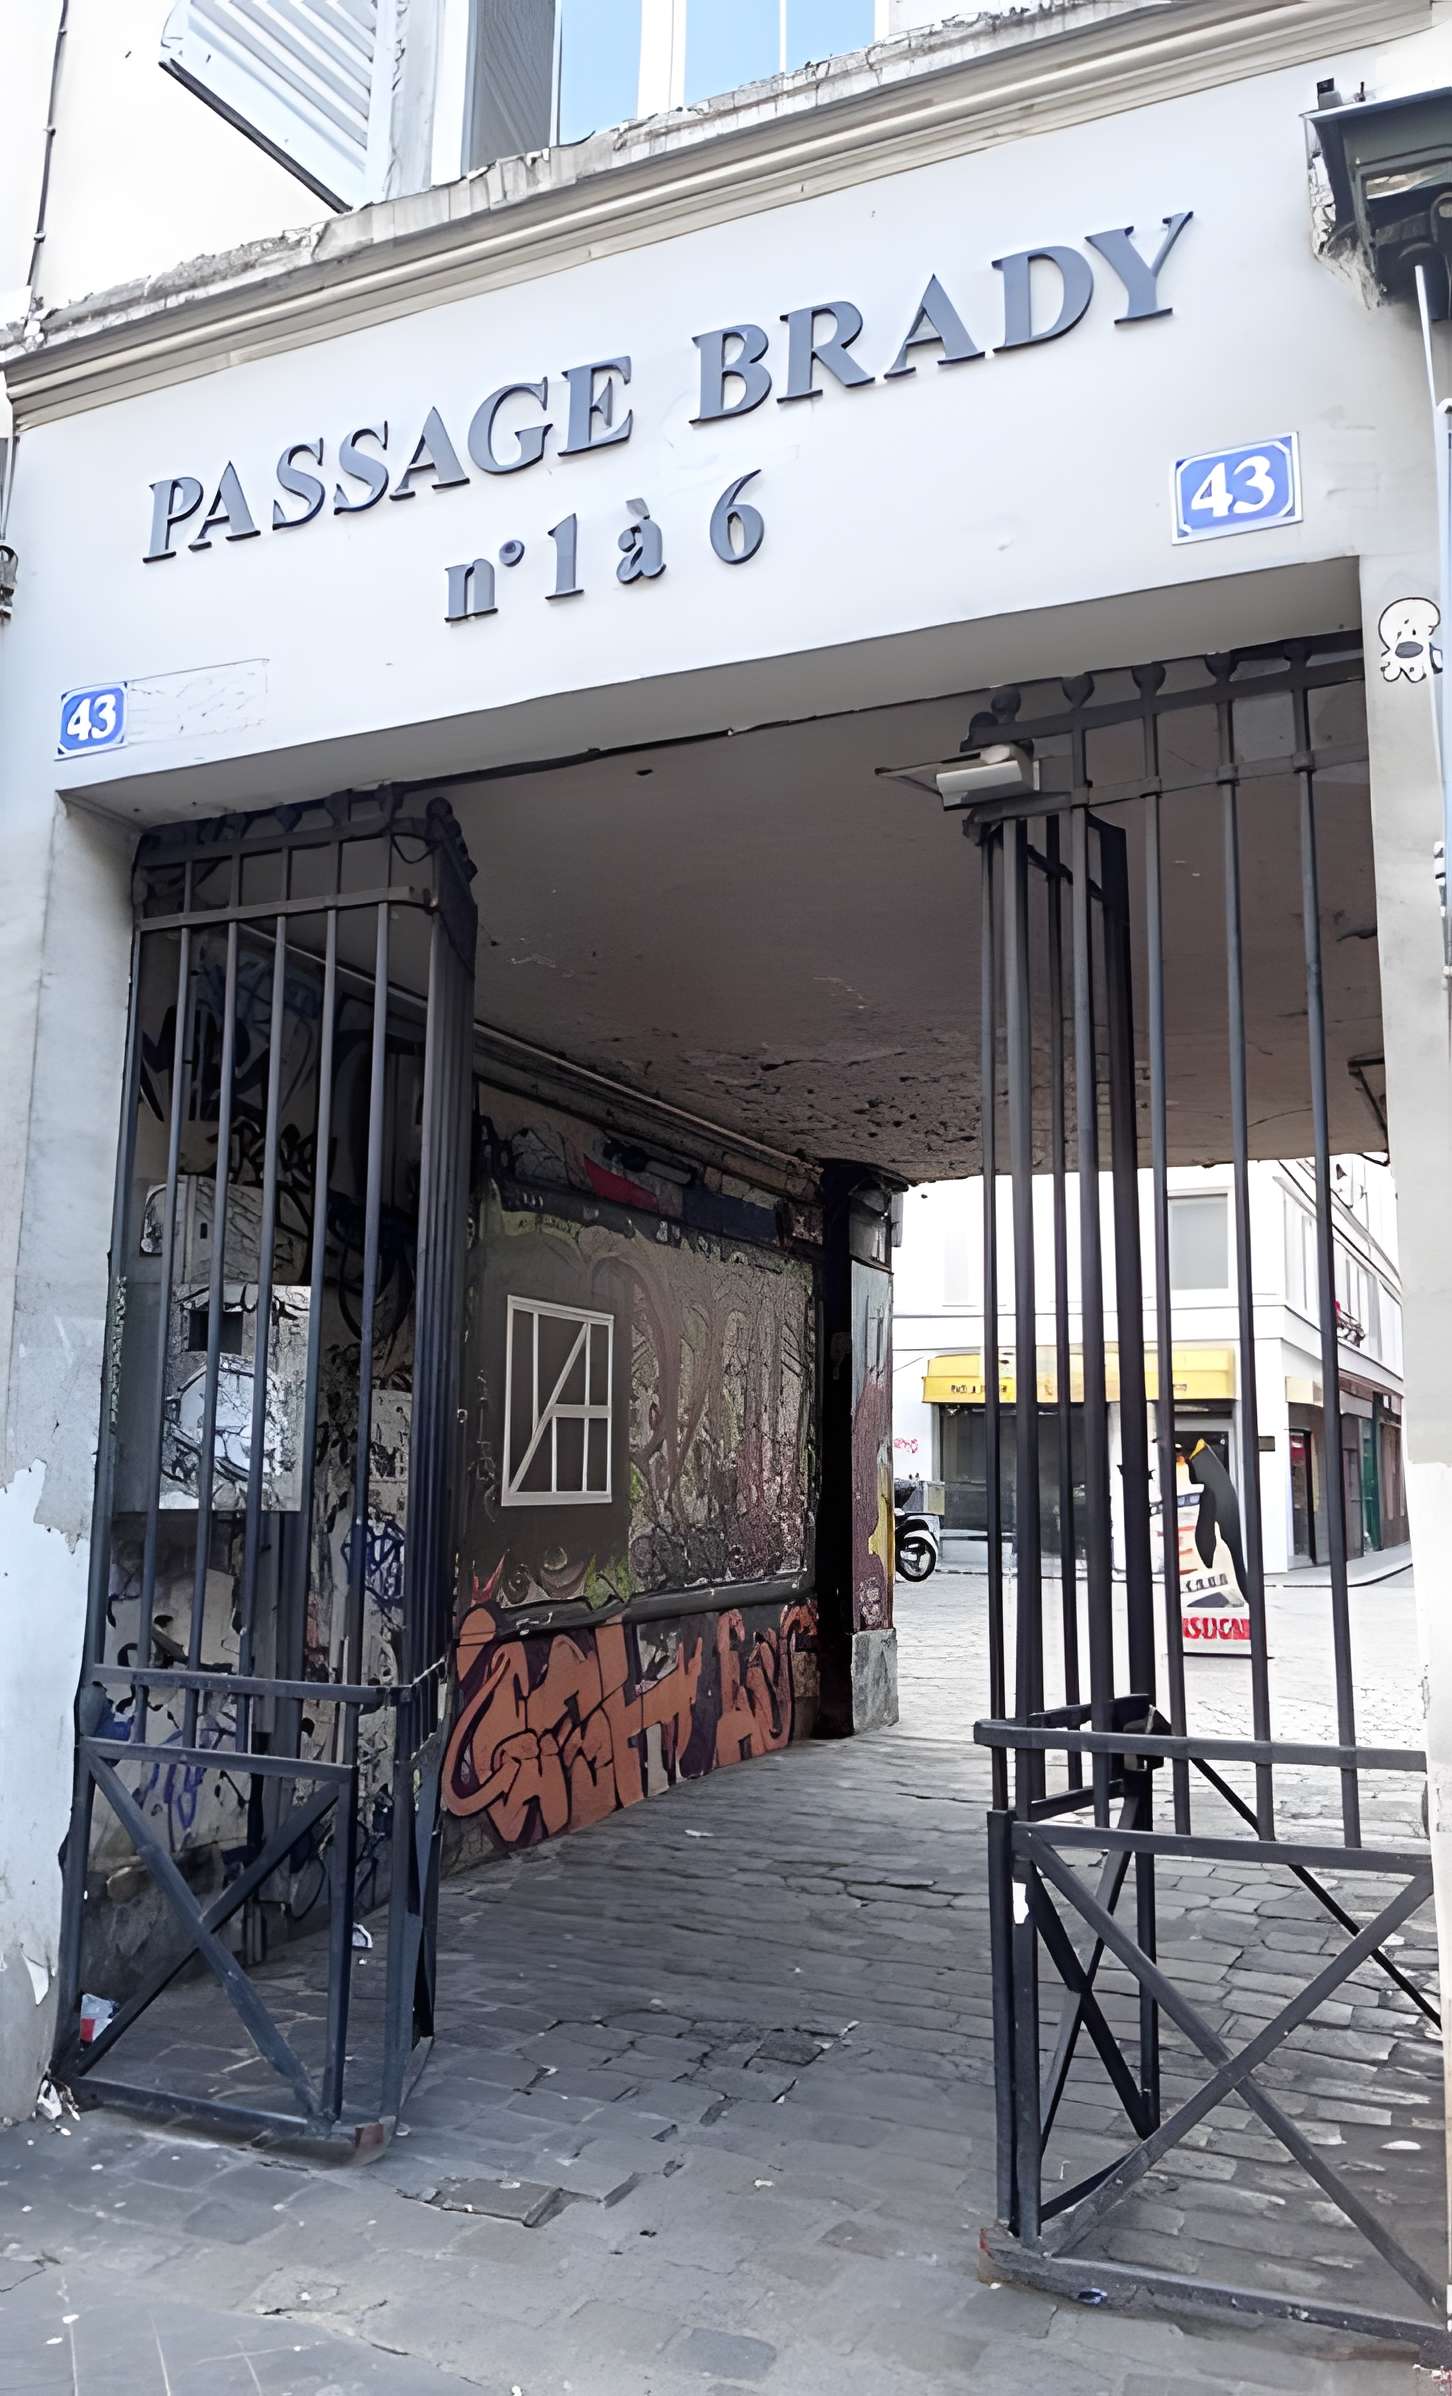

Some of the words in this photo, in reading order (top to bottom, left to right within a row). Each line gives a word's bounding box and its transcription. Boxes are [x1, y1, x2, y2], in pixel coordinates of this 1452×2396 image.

[142, 355, 634, 564] PASSAGE
[688, 211, 1195, 428] BRADY
[616, 497, 667, 584] à
[709, 469, 762, 564] 6
[1191, 455, 1275, 518] 43
[66, 694, 117, 741] 43
